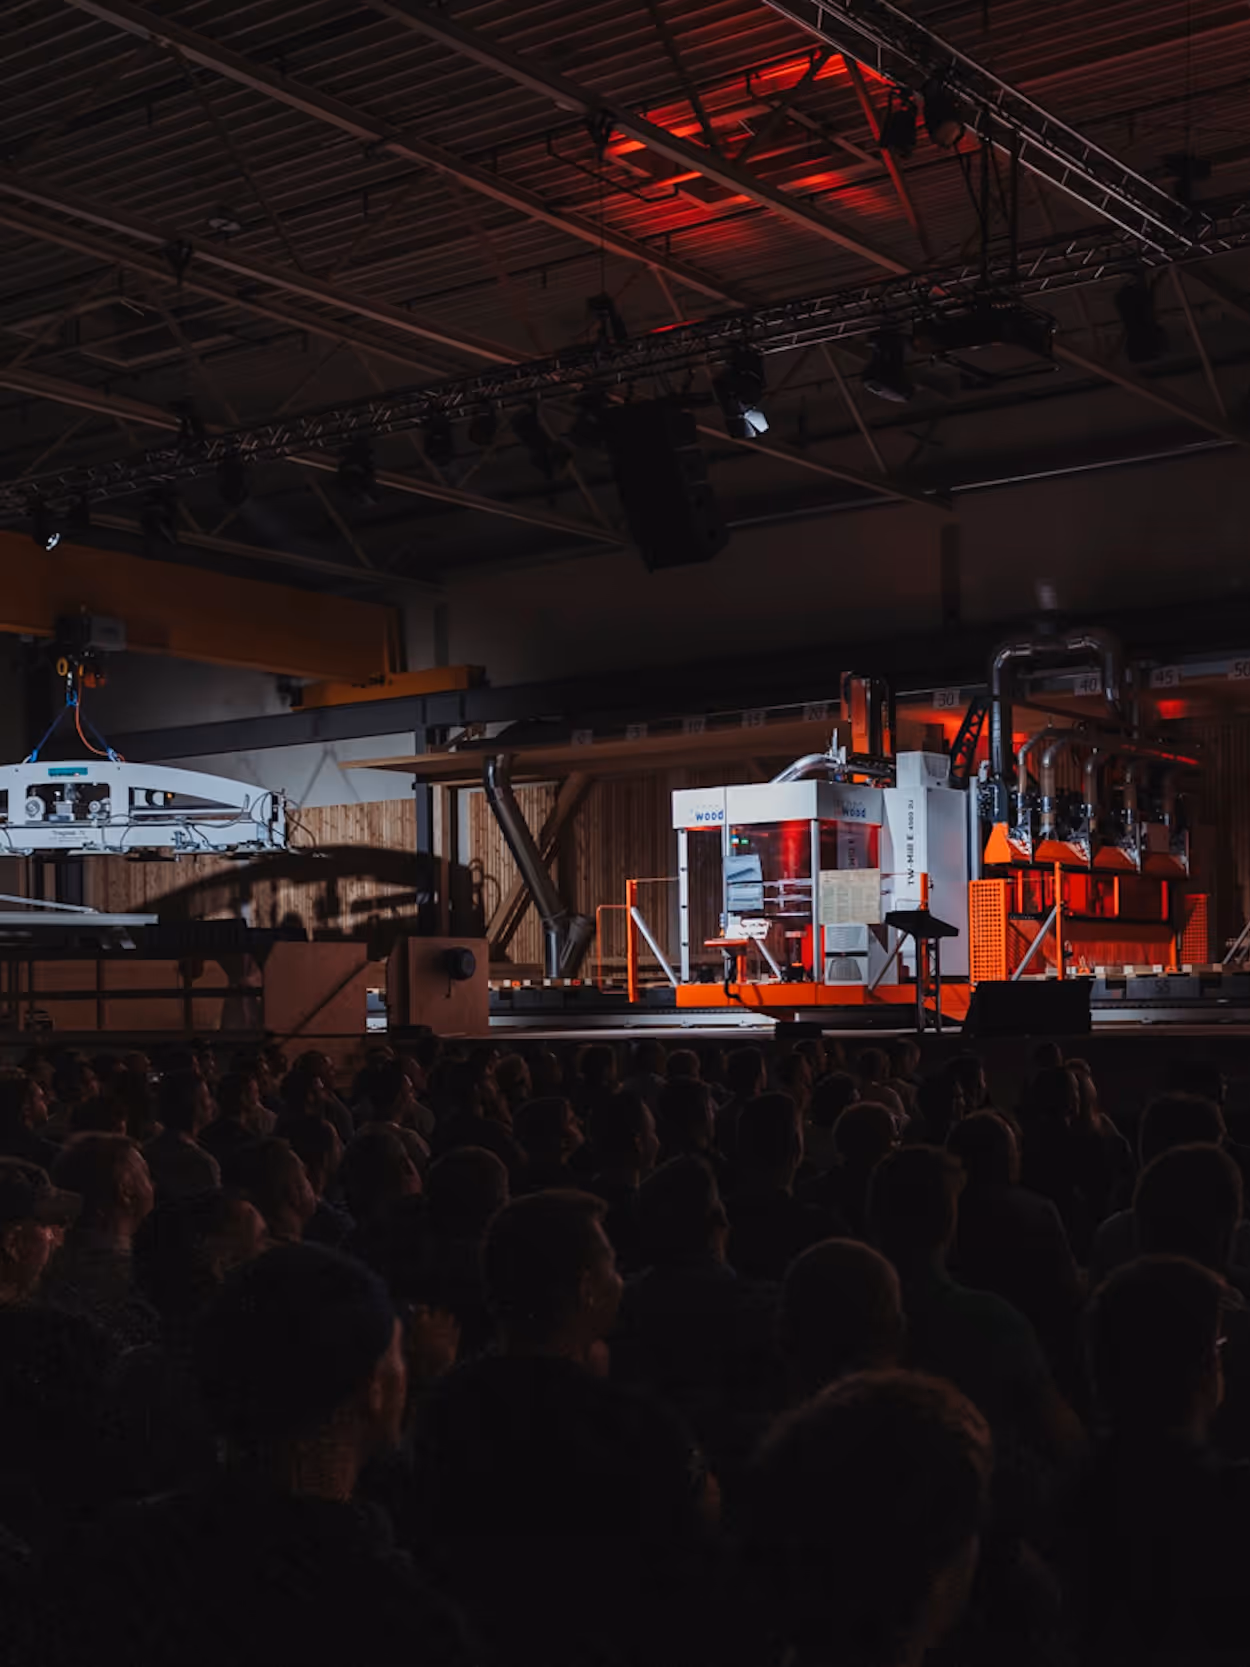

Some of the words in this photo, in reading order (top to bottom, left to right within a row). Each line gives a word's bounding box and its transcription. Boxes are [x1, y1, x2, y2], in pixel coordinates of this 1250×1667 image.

[1155, 672, 1173, 684] 45
[1080, 680, 1098, 692] 40
[695, 810, 724, 821] wood
